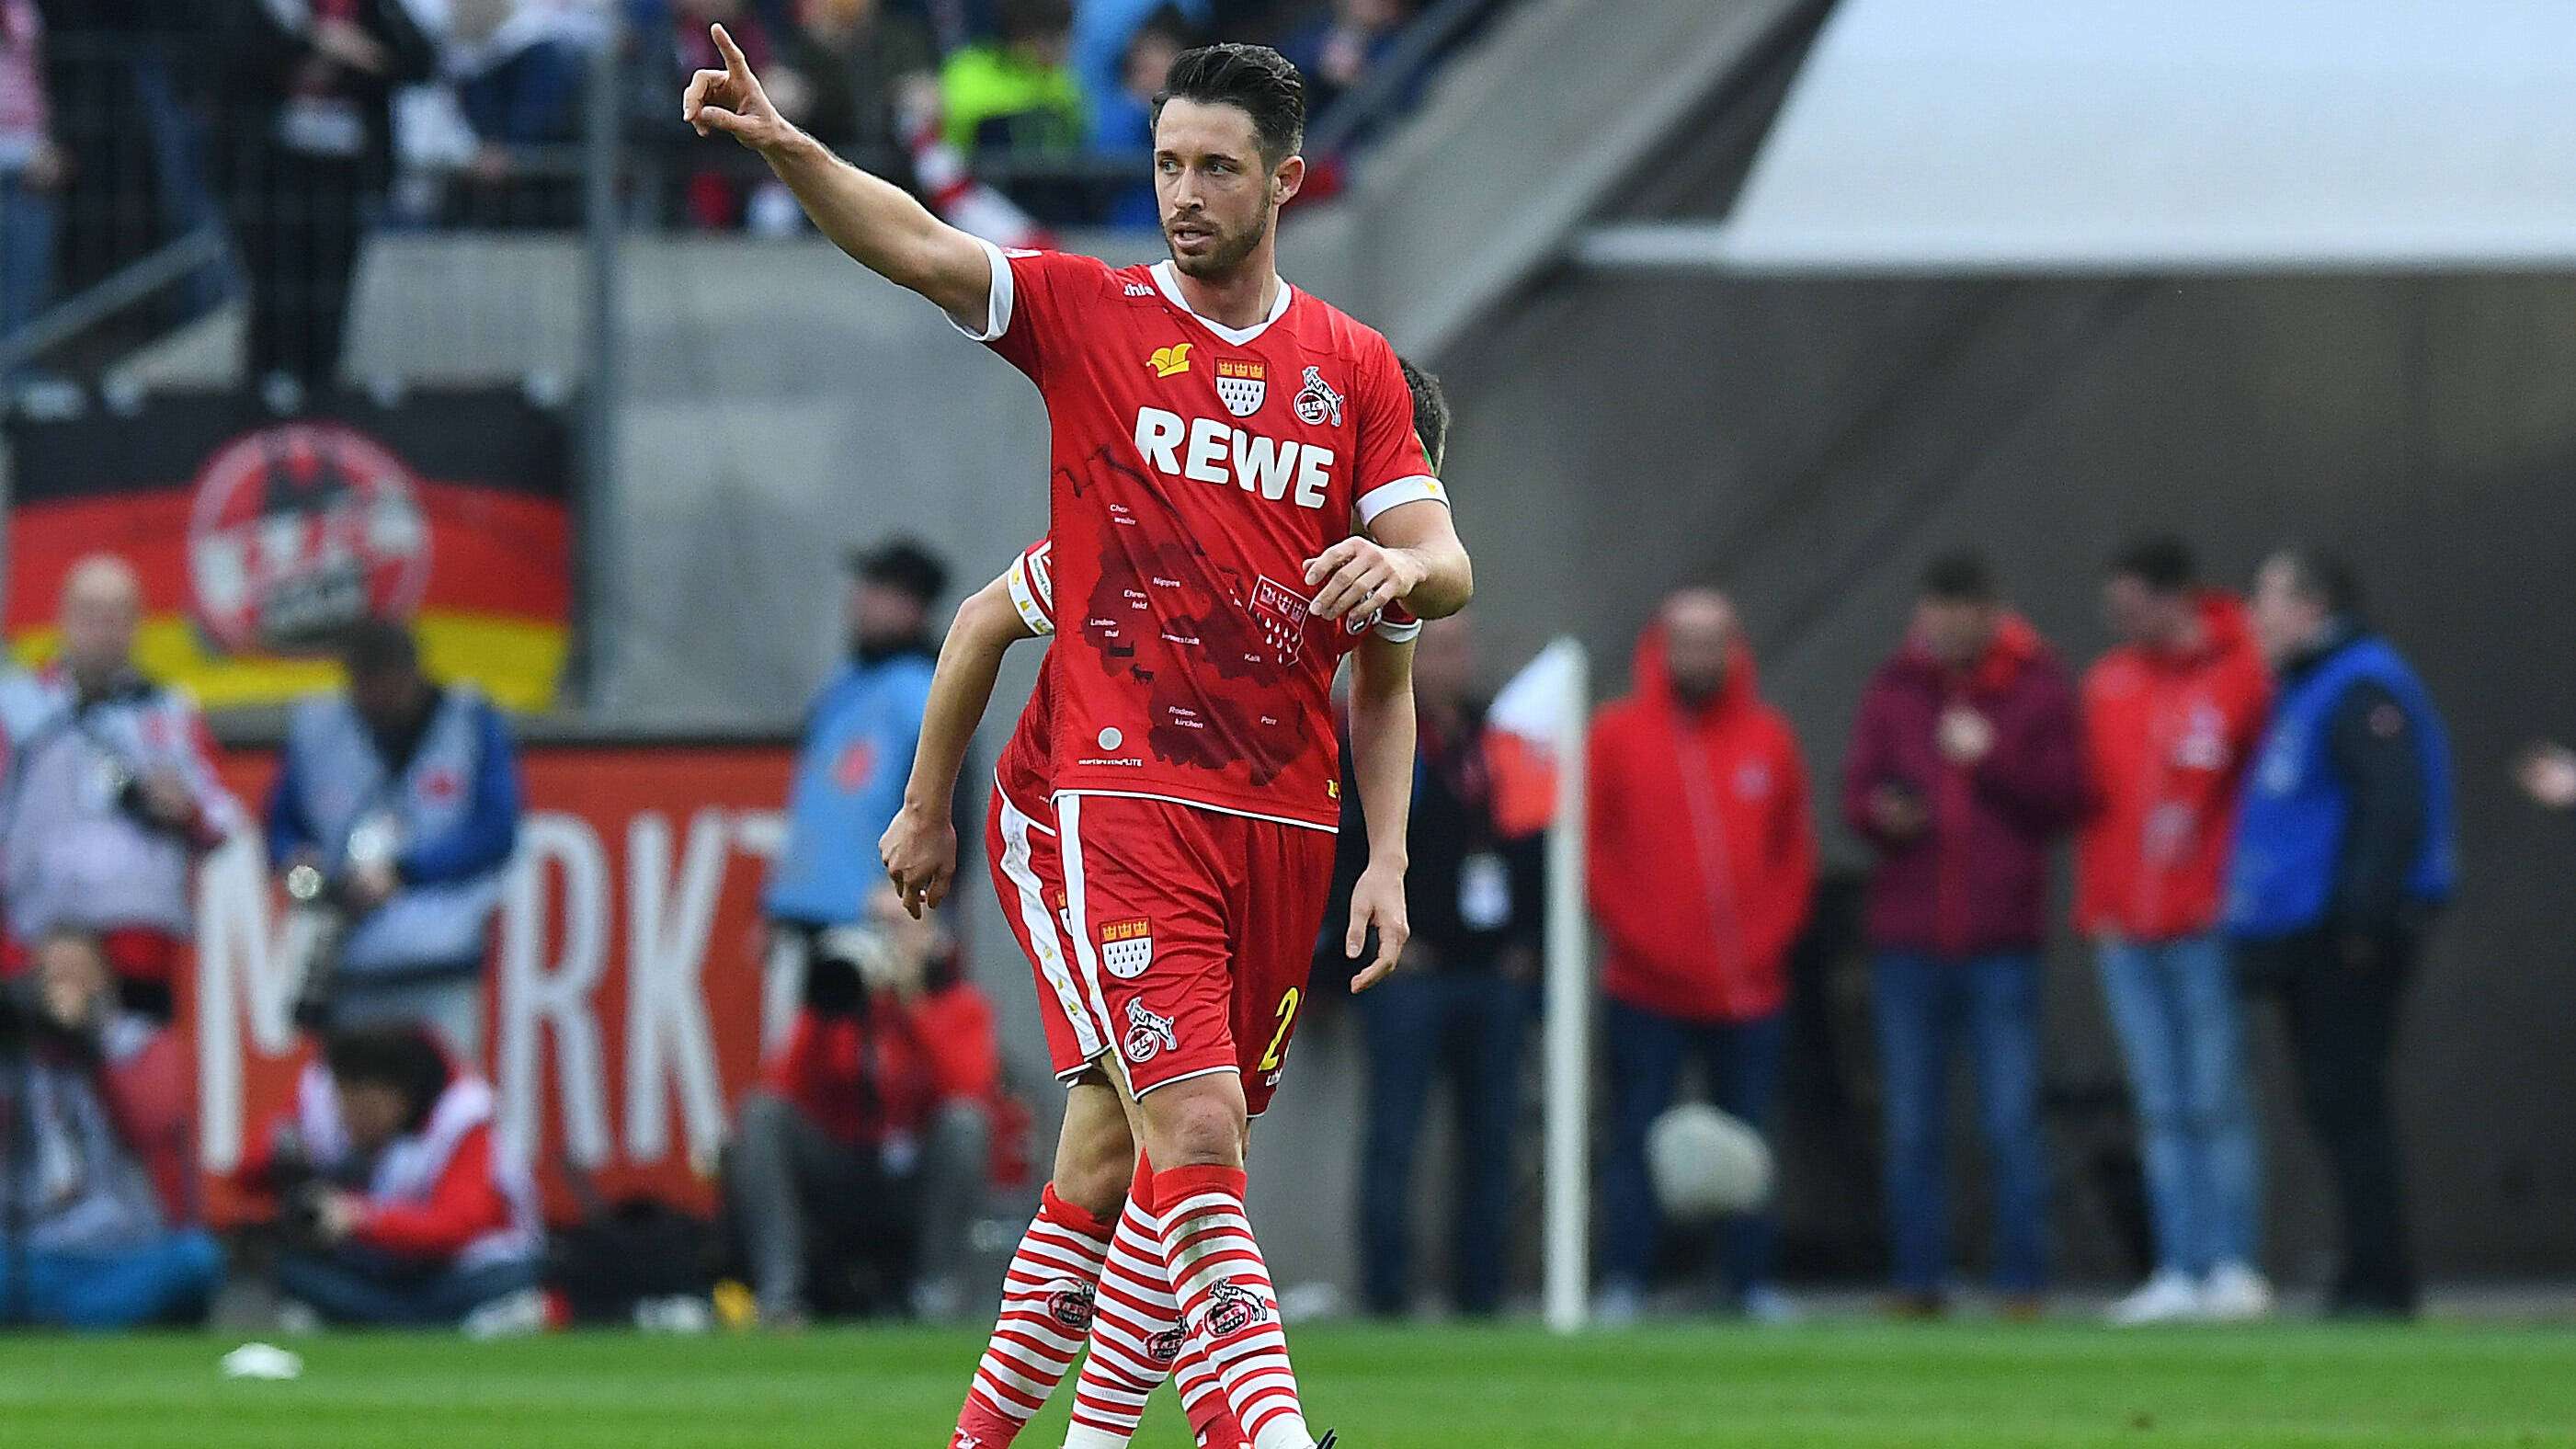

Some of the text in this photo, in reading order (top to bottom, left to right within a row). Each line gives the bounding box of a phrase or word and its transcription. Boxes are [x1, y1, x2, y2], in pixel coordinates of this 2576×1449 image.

[1134, 406, 1334, 509] REWE
[1153, 576, 1180, 588] Nippes
[1132, 600, 1148, 610] feld
[1244, 653, 1260, 663] Kalk
[1168, 705, 1197, 717] Roden-
[1175, 718, 1203, 729] kirchen
